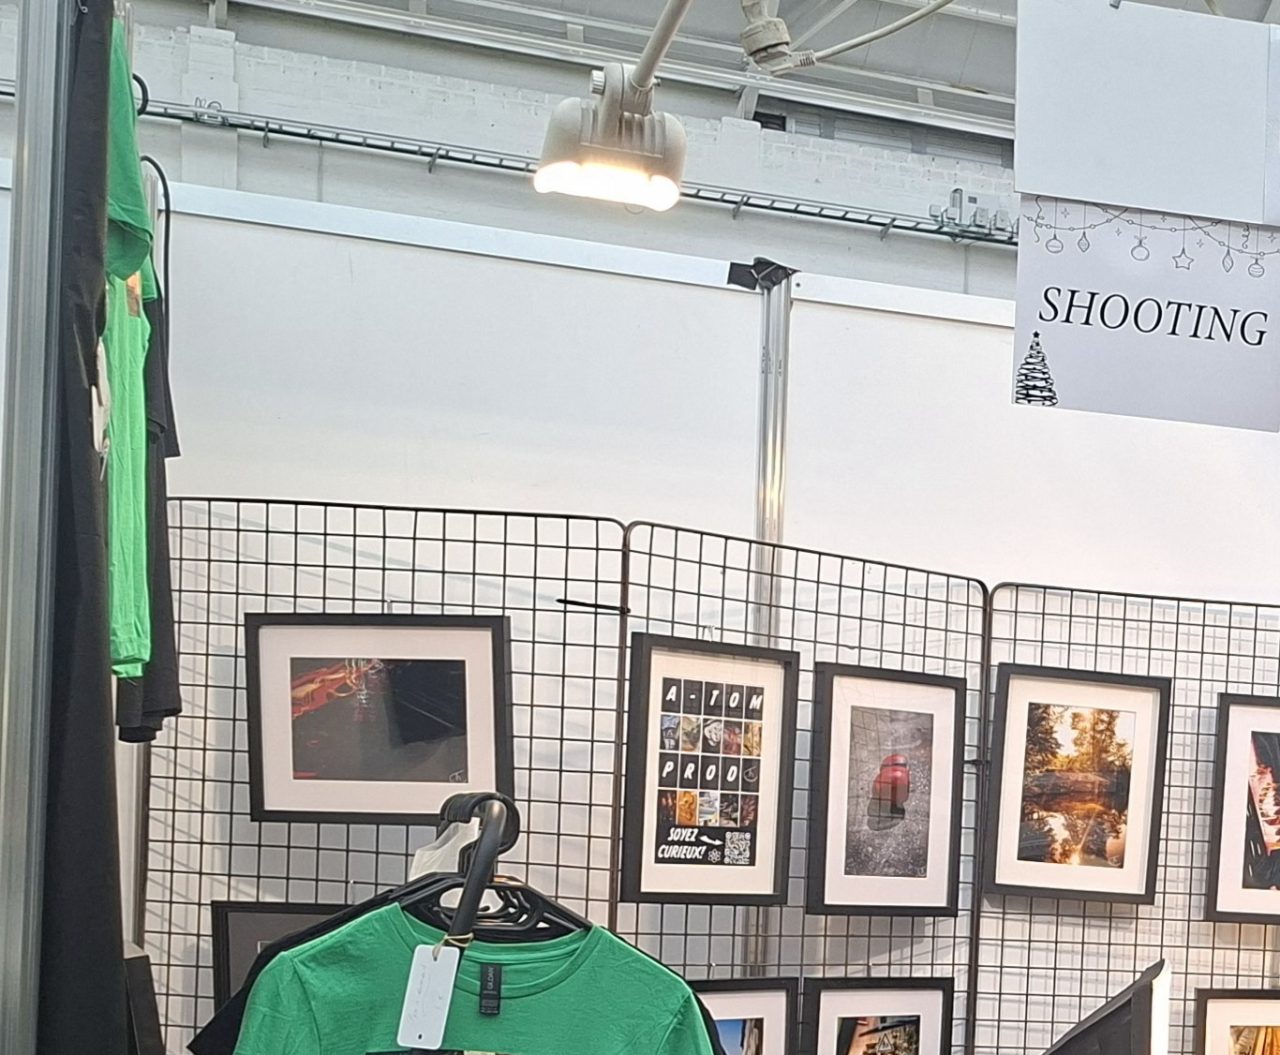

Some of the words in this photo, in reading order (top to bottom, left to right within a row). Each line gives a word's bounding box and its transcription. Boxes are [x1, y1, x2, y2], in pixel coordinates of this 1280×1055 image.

[1038, 286, 1269, 347] SHOOTING
[667, 827, 699, 842] SOYEZ
[657, 844, 707, 860] CURIEUX!
